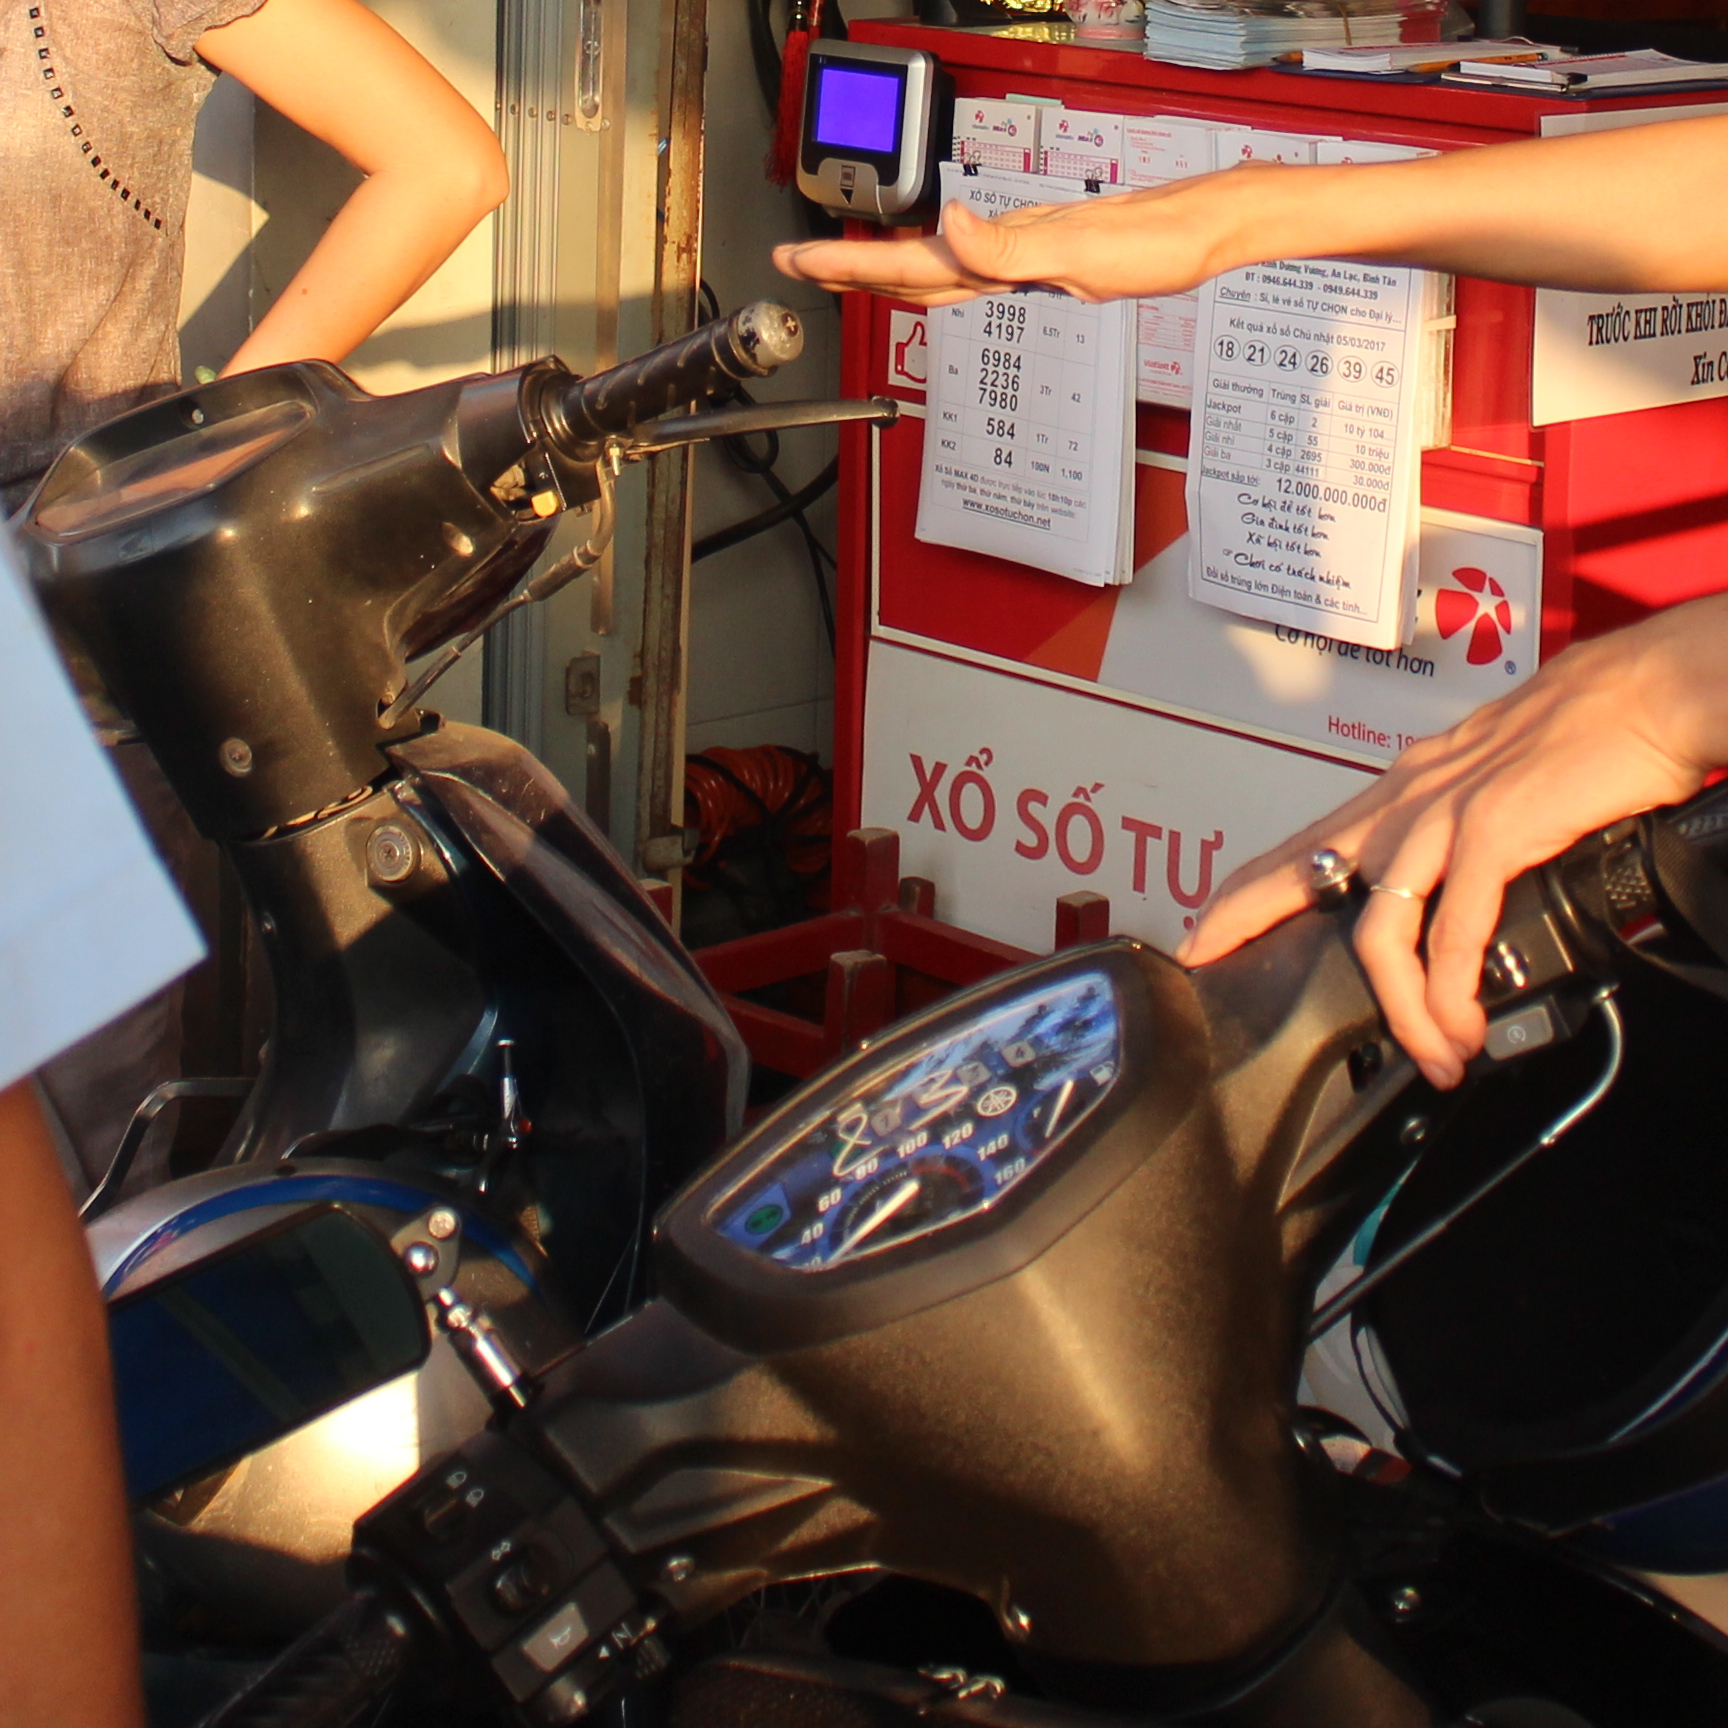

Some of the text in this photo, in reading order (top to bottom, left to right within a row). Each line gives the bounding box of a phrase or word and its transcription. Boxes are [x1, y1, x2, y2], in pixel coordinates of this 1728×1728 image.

[985, 300, 1027, 325] 3998
[1306, 299, 1320, 312] TỰ
[1320, 302, 1348, 316] CHỌN
[1350, 306, 1367, 319] cho
[1587, 301, 1631, 347] TRƯỚC
[1633, 306, 1658, 341] KHI
[1660, 295, 1684, 338] RỜI
[983, 320, 1025, 344] 4197
[1075, 334, 1085, 345] 13
[1336, 334, 1387, 353] 05/03/2017
[981, 347, 1022, 373] 6984
[1217, 339, 1396, 386] 18 21 24 26 39 45
[1690, 350, 1715, 387] Xin
[977, 387, 1019, 412] 7980
[978, 368, 1020, 393] 2236
[1070, 393, 1082, 404] 42
[1300, 393, 1312, 404] SL
[942, 411, 958, 423] KK1
[986, 417, 1016, 440] 584
[1068, 440, 1079, 452] 72
[1206, 397, 1243, 416] Jackpot
[1270, 410, 1277, 421] 6
[1310, 417, 1319, 429] 2
[1343, 423, 1354, 435] 10
[940, 438, 957, 451] KK2
[993, 448, 1013, 469] 84
[1268, 427, 1275, 438] 5
[1306, 435, 1319, 447] 55
[1355, 444, 1366, 455] 10
[1265, 458, 1272, 468] 3
[1294, 463, 1320, 478] 44111
[1352, 474, 1390, 491] 30.000đ
[1266, 443, 1274, 454] 4
[1300, 449, 1323, 463] 2695
[1349, 457, 1392, 476] 300.000đ
[1275, 477, 1388, 513] 12.000.000.000đ
[1314, 594, 1323, 605] &
[1395, 646, 1436, 678] hơn
[1327, 714, 1392, 750] Hotline:
[906, 745, 1226, 933] XỔ SỐ TỰ
[895, 1131, 929, 1159] 100
[941, 1122, 973, 1150] 120
[976, 1133, 1010, 1162] 140
[817, 1187, 842, 1213] 60
[800, 1223, 825, 1246] 40
